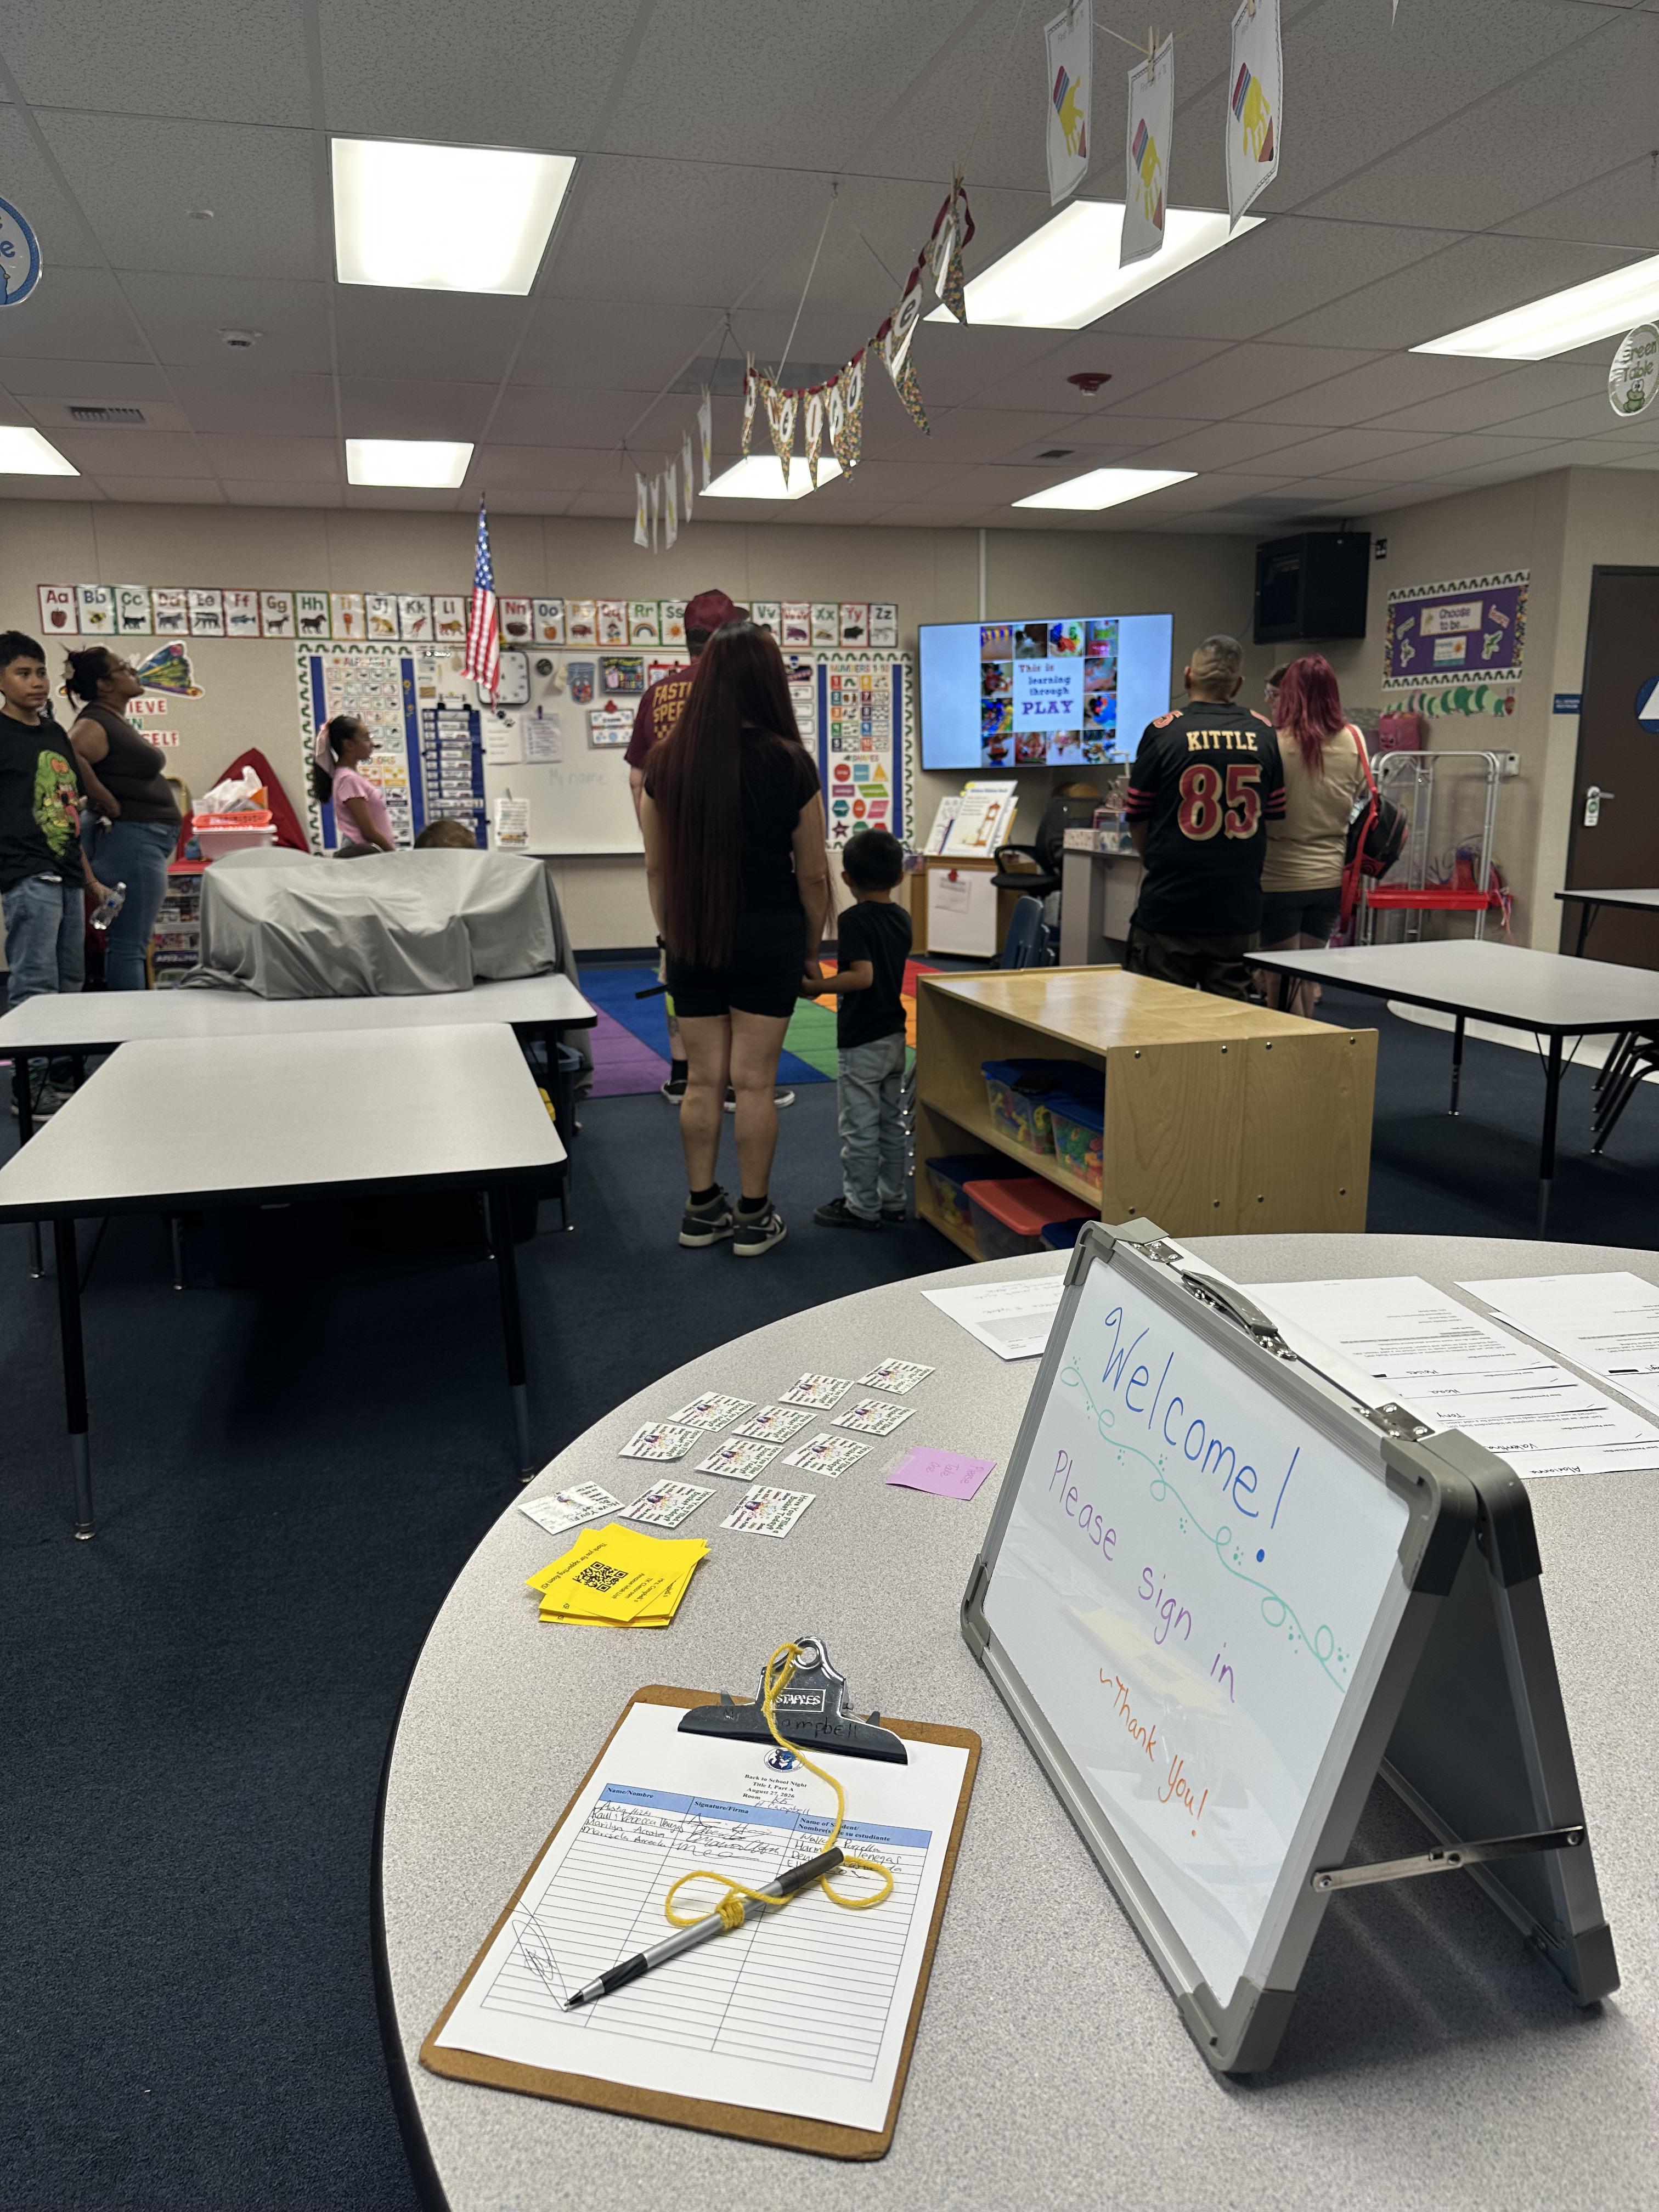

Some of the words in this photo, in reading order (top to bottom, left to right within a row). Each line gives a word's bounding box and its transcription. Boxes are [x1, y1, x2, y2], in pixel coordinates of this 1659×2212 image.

[47, 590, 69, 603] Aa
[84, 590, 106, 603] Bb
[121, 592, 143, 605] Cc
[267, 596, 287, 613] Gg
[302, 596, 323, 611] Hh
[372, 597, 389, 614] Jj
[407, 601, 426, 614] Kk
[443, 601, 454, 614] Ll
[505, 603, 526, 615] Nn
[539, 604, 558, 617] Oo
[634, 604, 654, 618] Rr
[758, 606, 776, 619] Vv
[815, 607, 834, 620] Xx
[846, 607, 863, 622] Yy
[876, 608, 891, 620] Zz
[1439, 607, 1471, 619] Choose
[1018, 664, 1041, 673] This
[1046, 663, 1054, 672] is
[1029, 675, 1071, 686] learning
[1030, 687, 1070, 697] through
[128, 699, 166, 714] IEVE
[1022, 700, 1074, 715] PLAY
[1186, 730, 1258, 752] KITTLE
[1177, 764, 1262, 841] 85
[1102, 1307, 1300, 1563] Welcome!
[937, 1463, 962, 1479] Take
[957, 1465, 984, 1485] Please
[681, 1492, 701, 1505] Bucket
[695, 1492, 711, 1501] Have
[780, 1496, 797, 1510] Bucket
[794, 1496, 808, 1505] Have
[661, 1505, 685, 1521] Today?
[672, 1510, 689, 1521] Filled
[786, 1507, 798, 1516] You
[764, 1511, 785, 1529] Today?
[776, 1517, 791, 1530] Filled
[557, 1560, 582, 1575] supporting
[628, 1573, 645, 1584] Amazon
[1049, 1449, 1117, 1561] Please
[1210, 1642, 1235, 1703] in
[625, 1582, 646, 1598] Classroom
[776, 1694, 821, 1705] STAPLES
[781, 1717, 858, 1739] ampbell
[608, 1787, 654, 1798] Name/Nombre
[695, 1801, 749, 1814] Signature/Firma
[768, 1803, 810, 1815] Campbell
[585, 1819, 623, 1832] Marilyn
[830, 1822, 860, 1831] Sdent/
[800, 1833, 839, 1847] Walkr
[855, 1833, 890, 1842] estudiante
[795, 1841, 823, 1853] Harm
